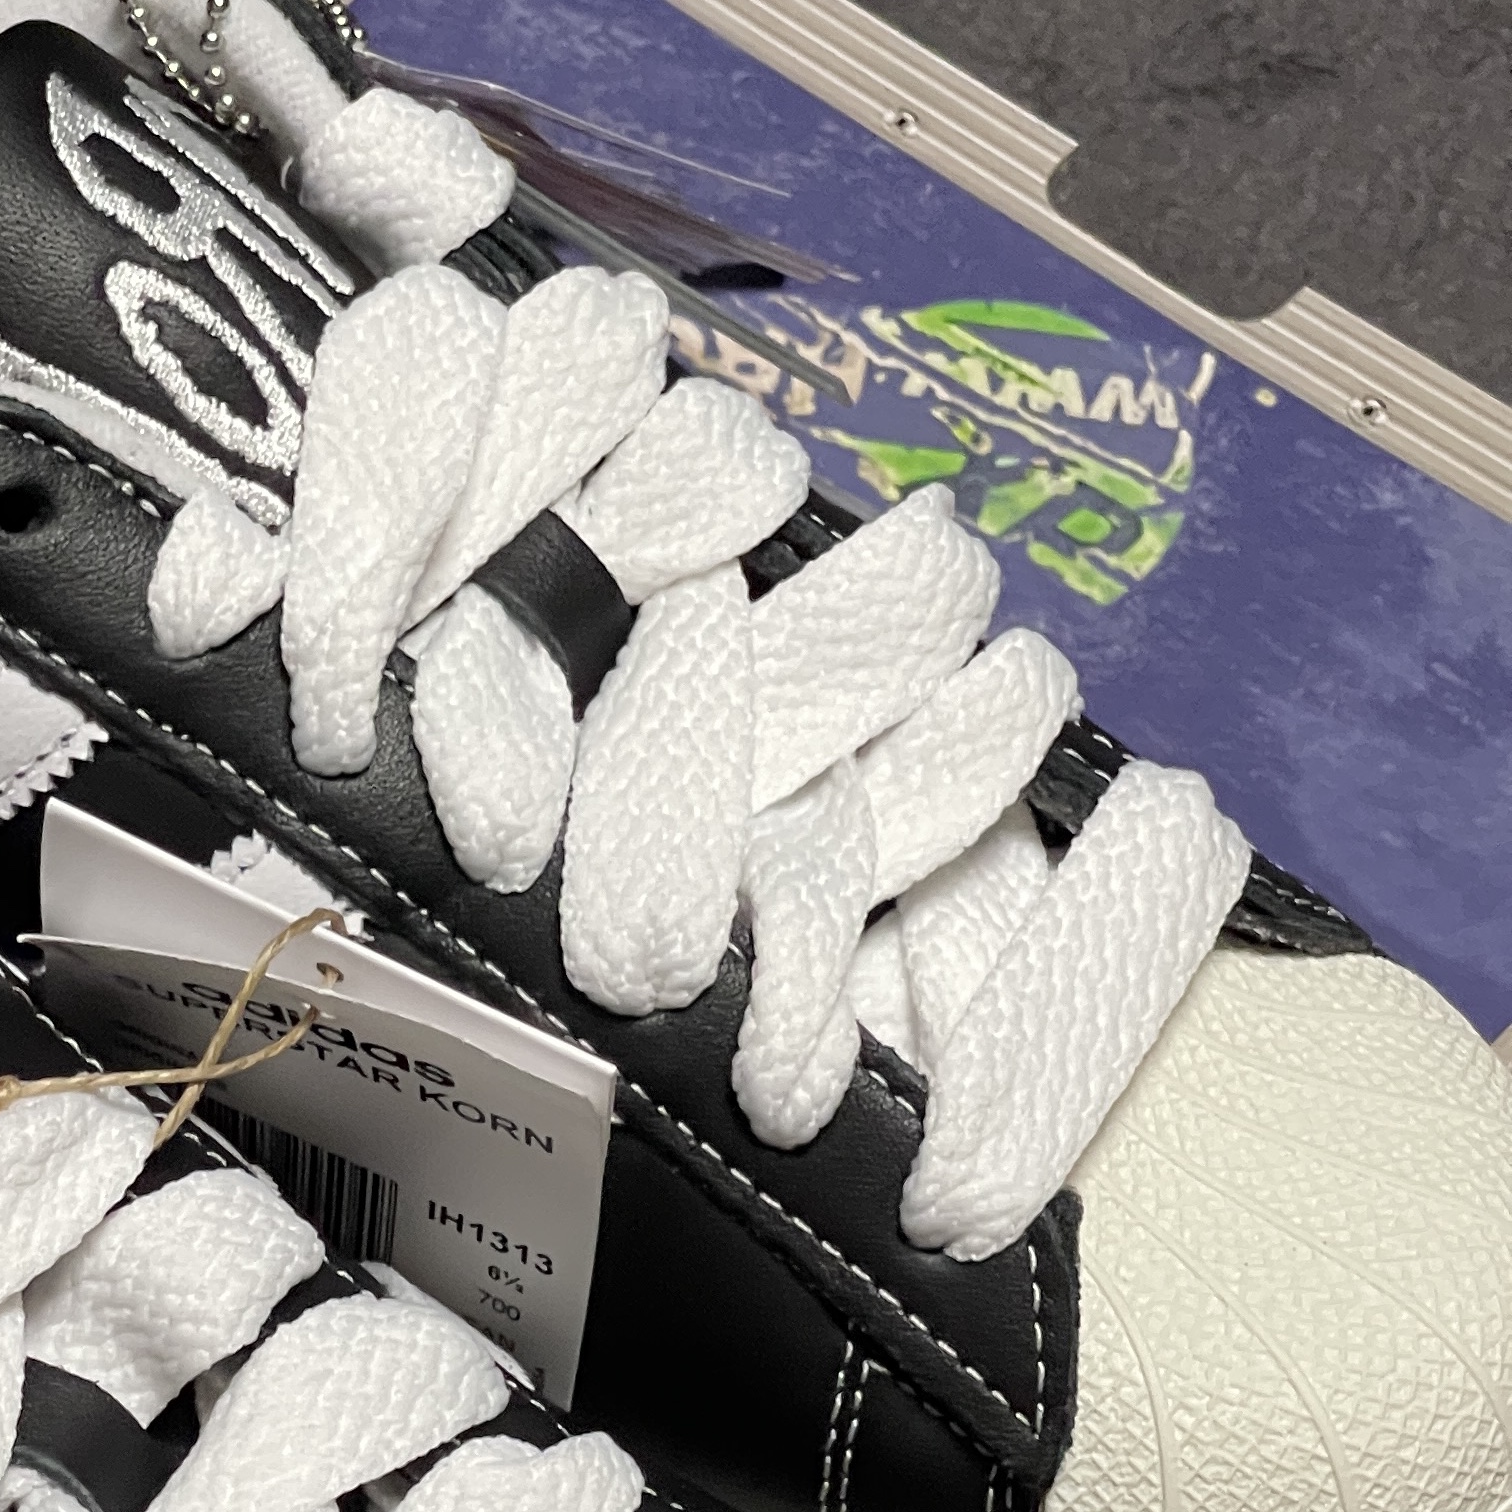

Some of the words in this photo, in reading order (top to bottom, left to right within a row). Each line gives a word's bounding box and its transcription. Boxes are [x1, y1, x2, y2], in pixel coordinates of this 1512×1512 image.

[115, 974, 403, 1092] UPERSTAR
[419, 1085, 555, 1154] KORN
[182, 981, 456, 1088] adidas
[428, 1199, 554, 1275] IH1313
